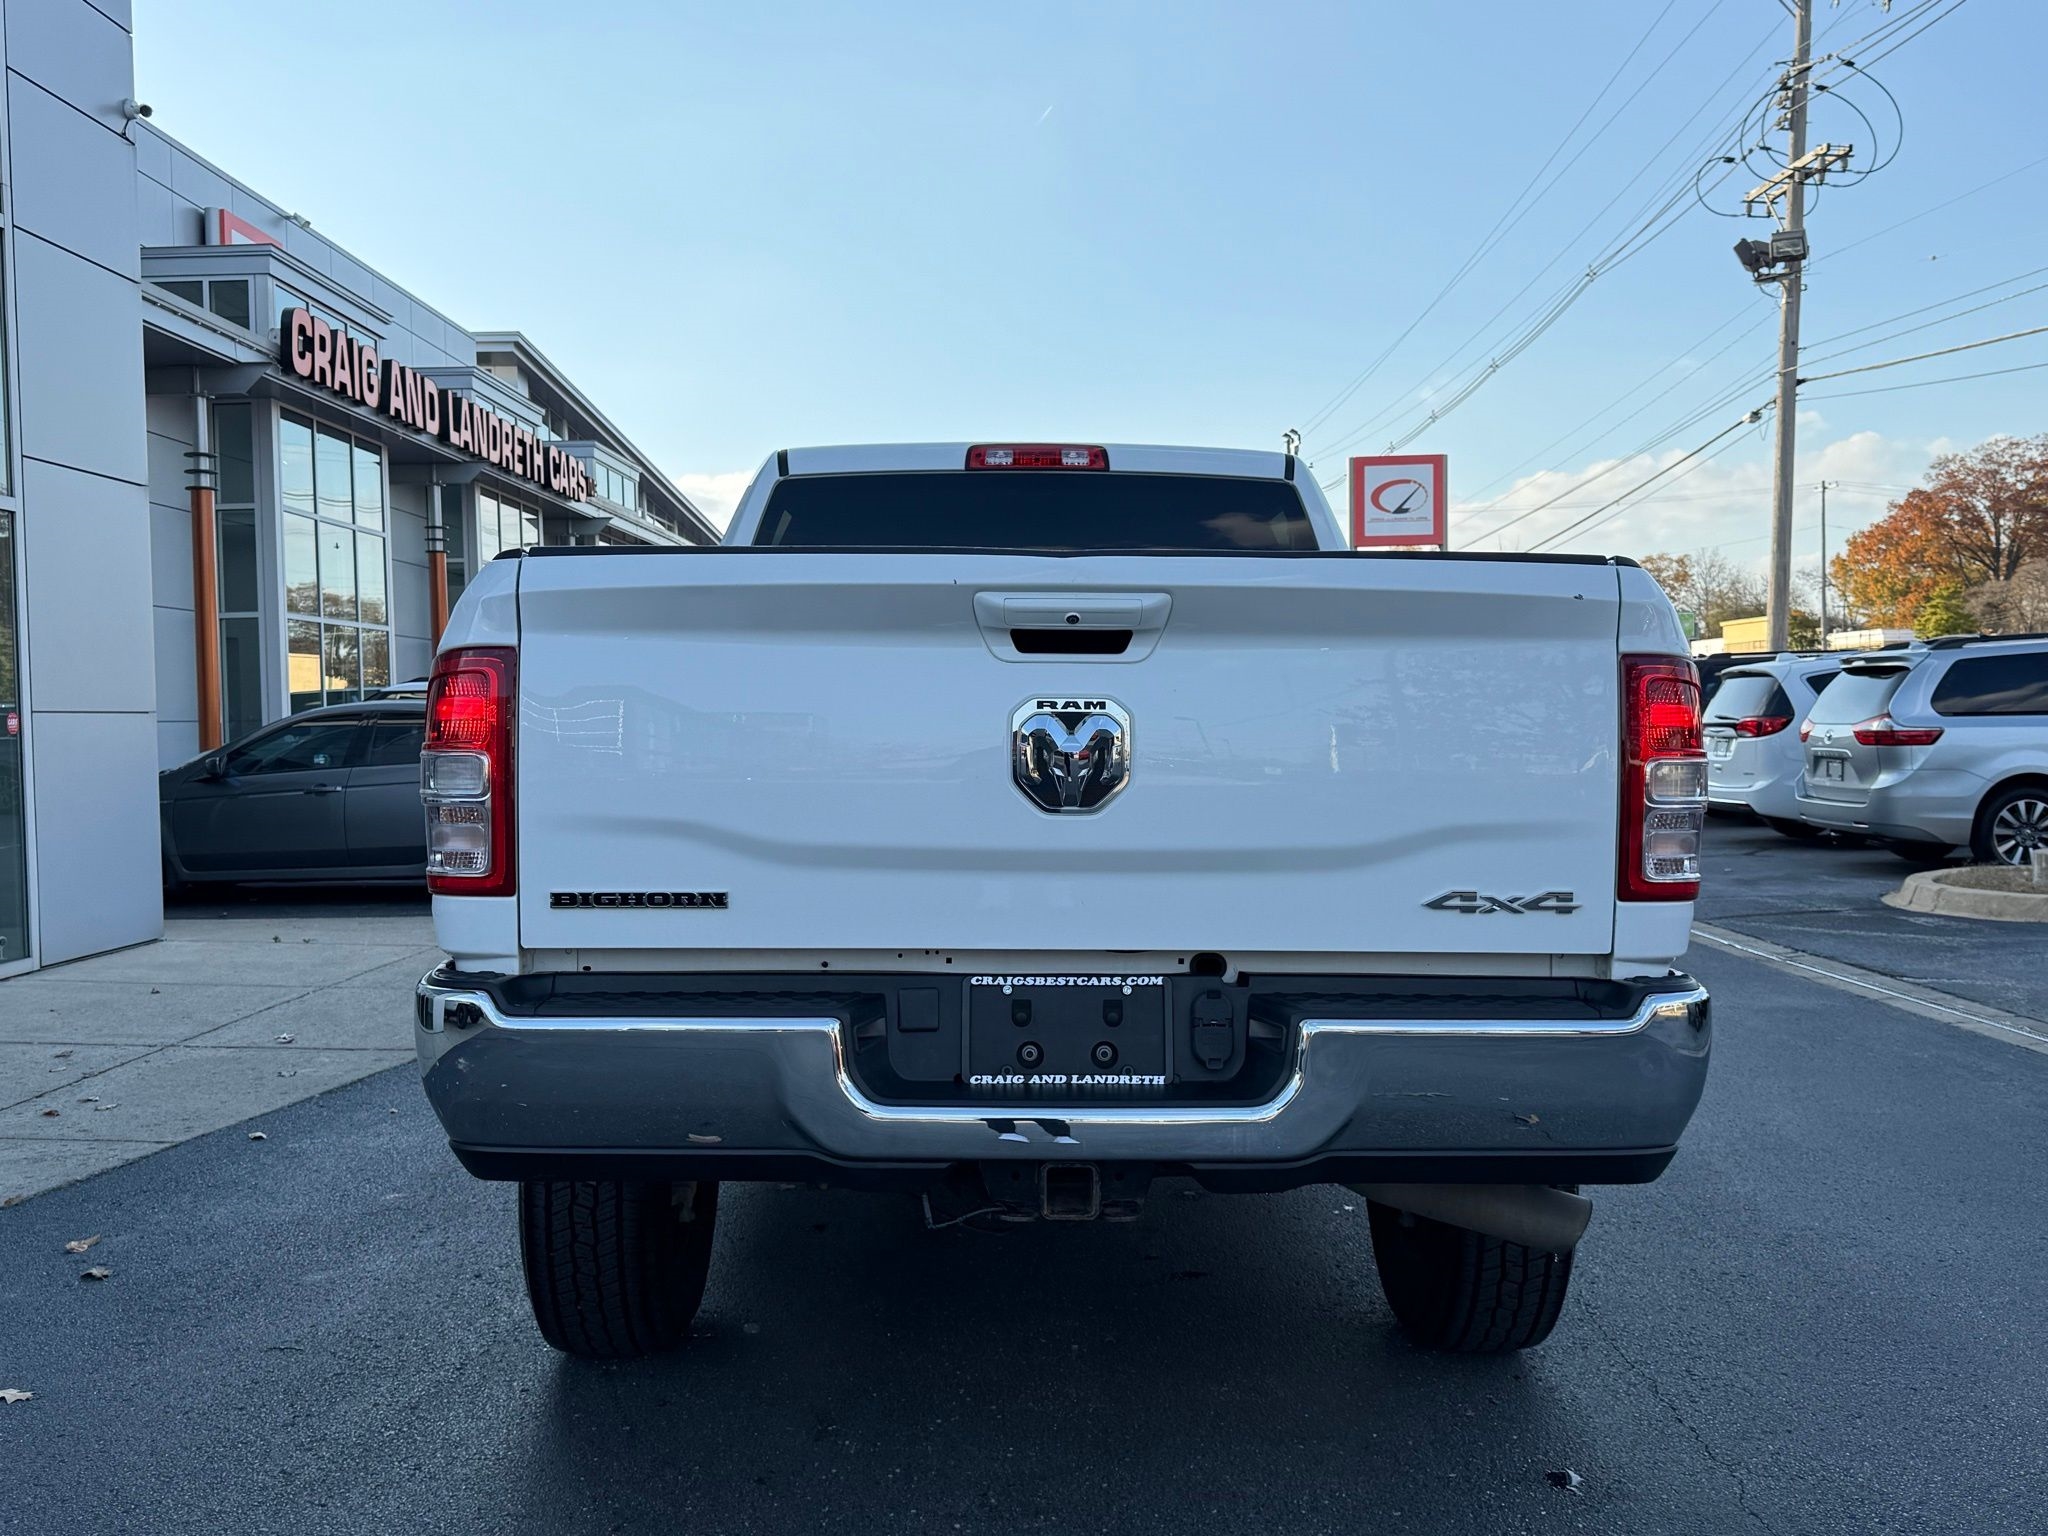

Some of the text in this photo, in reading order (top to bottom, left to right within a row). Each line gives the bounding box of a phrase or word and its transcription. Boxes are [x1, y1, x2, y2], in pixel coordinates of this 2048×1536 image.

[289, 307, 588, 503] CRAIG AND LANDRETH CARS
[1036, 700, 1107, 710] RAM
[550, 892, 728, 909] BIGHORN
[970, 976, 1164, 986] CRAIGSBESTCARS.COM
[969, 1074, 1166, 1086] CRAIG AND LANDRETH
